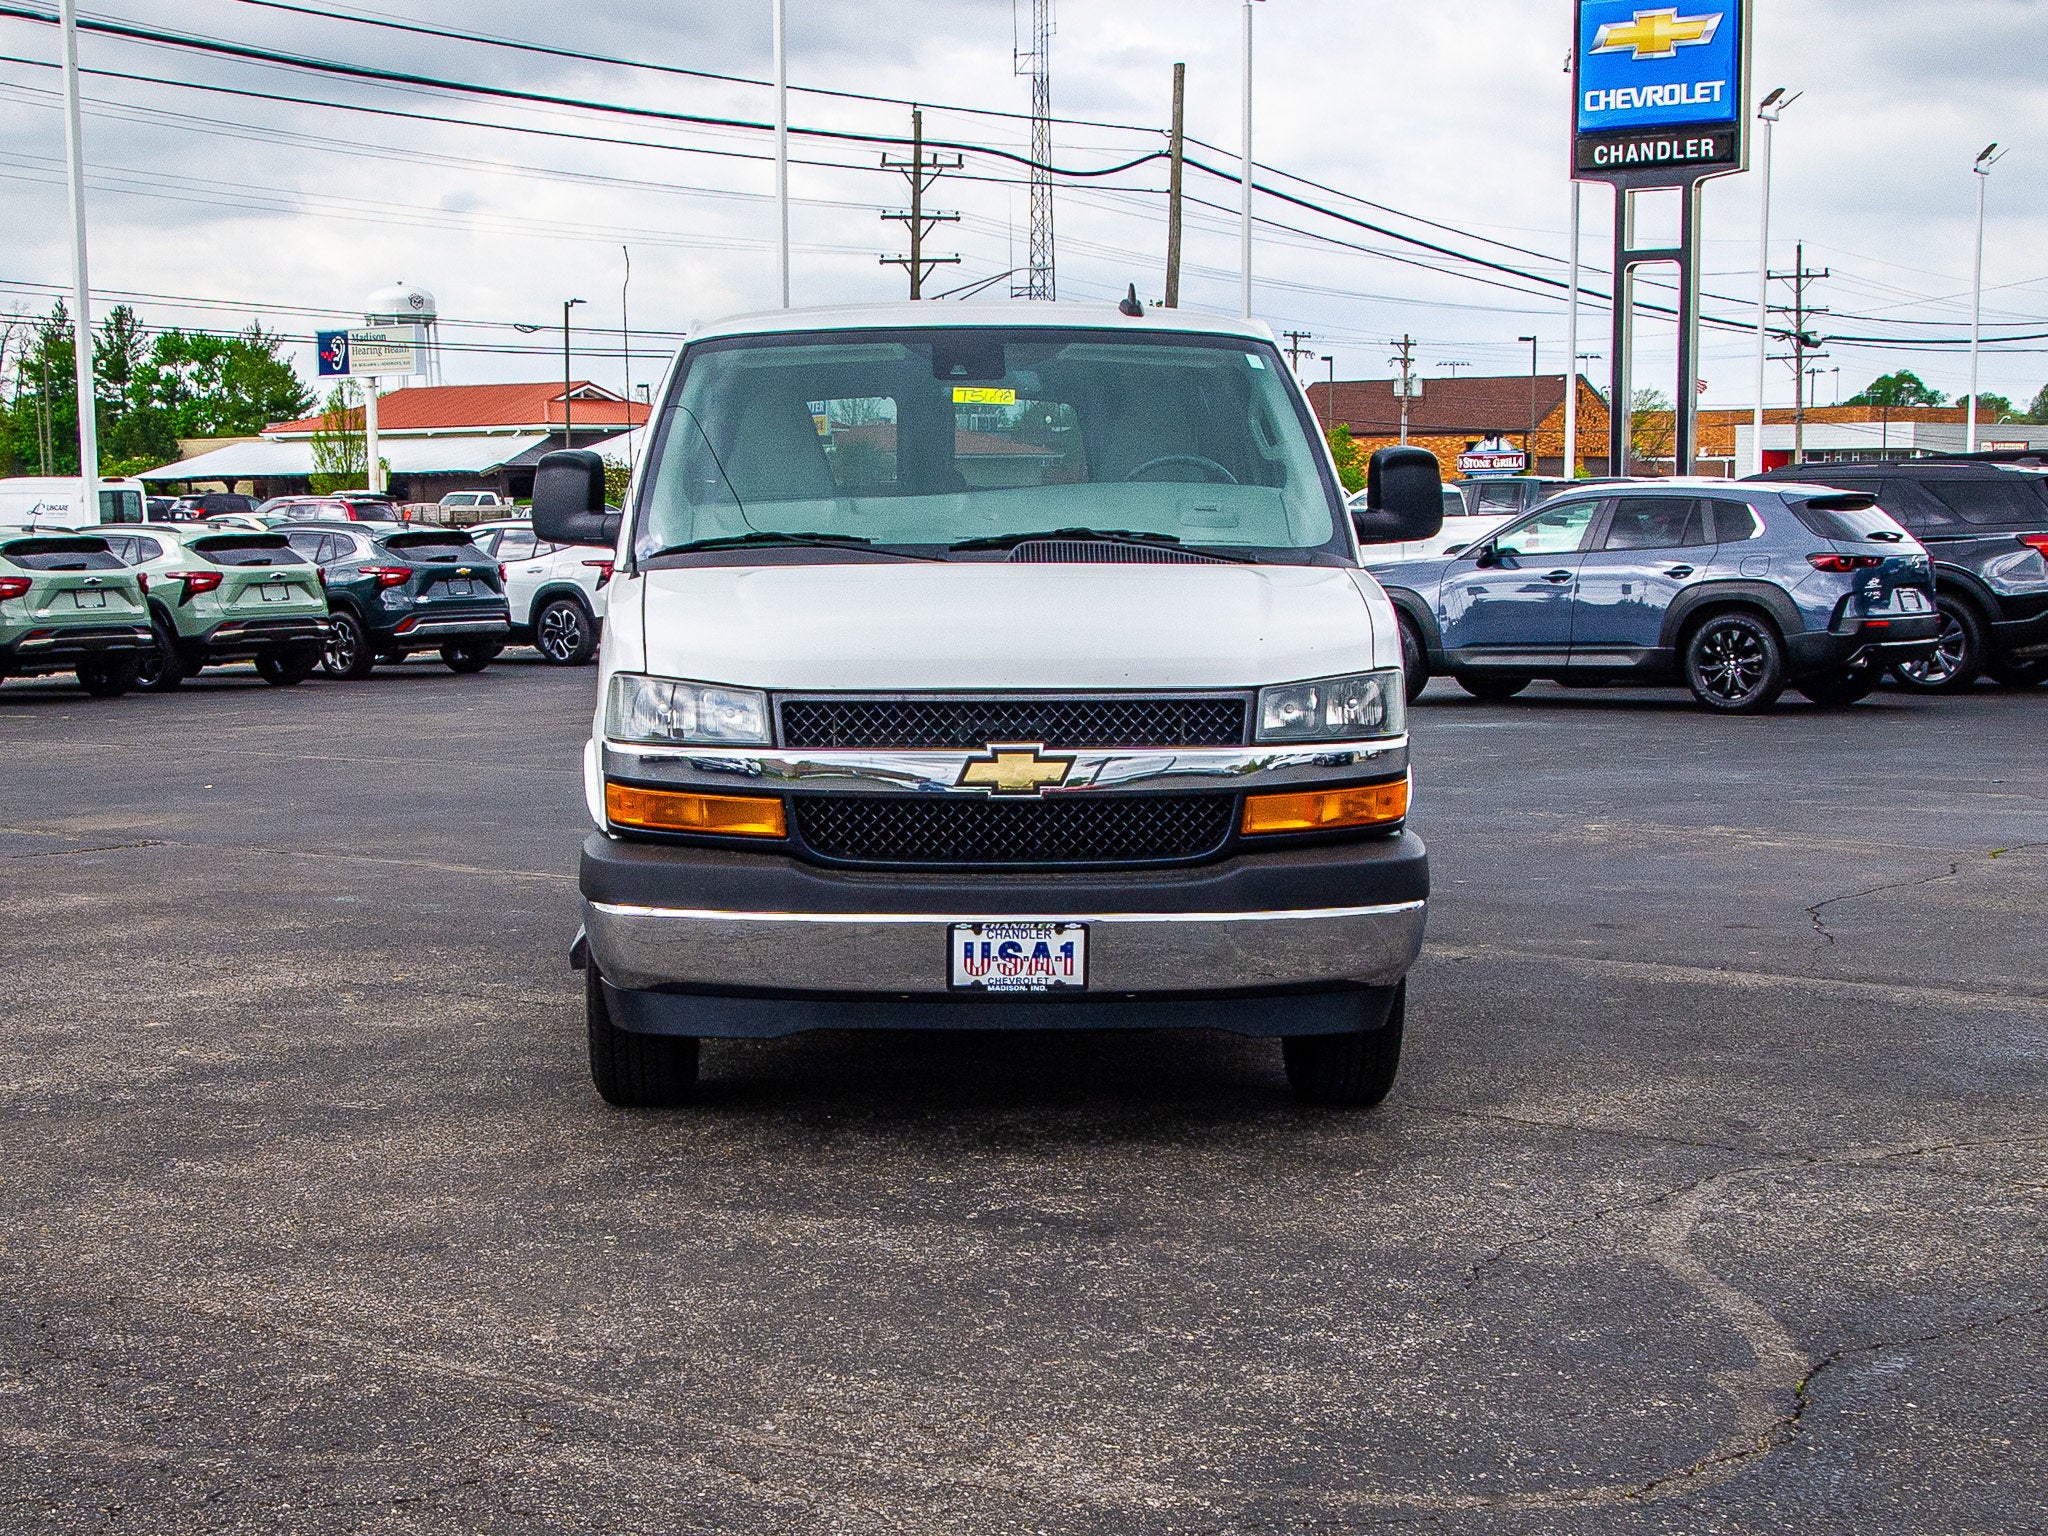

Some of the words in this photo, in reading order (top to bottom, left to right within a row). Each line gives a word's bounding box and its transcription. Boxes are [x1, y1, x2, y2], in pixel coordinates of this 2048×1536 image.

[1584, 80, 1726, 112] CHEVROLET
[1593, 138, 1714, 165] CHANDLER
[351, 346, 383, 357] Hearing
[1462, 456, 1492, 469] STONE
[1492, 456, 1519, 468] GRILL
[986, 929, 1052, 940] CHANDLER
[987, 976, 1050, 985] CHEVROLET
